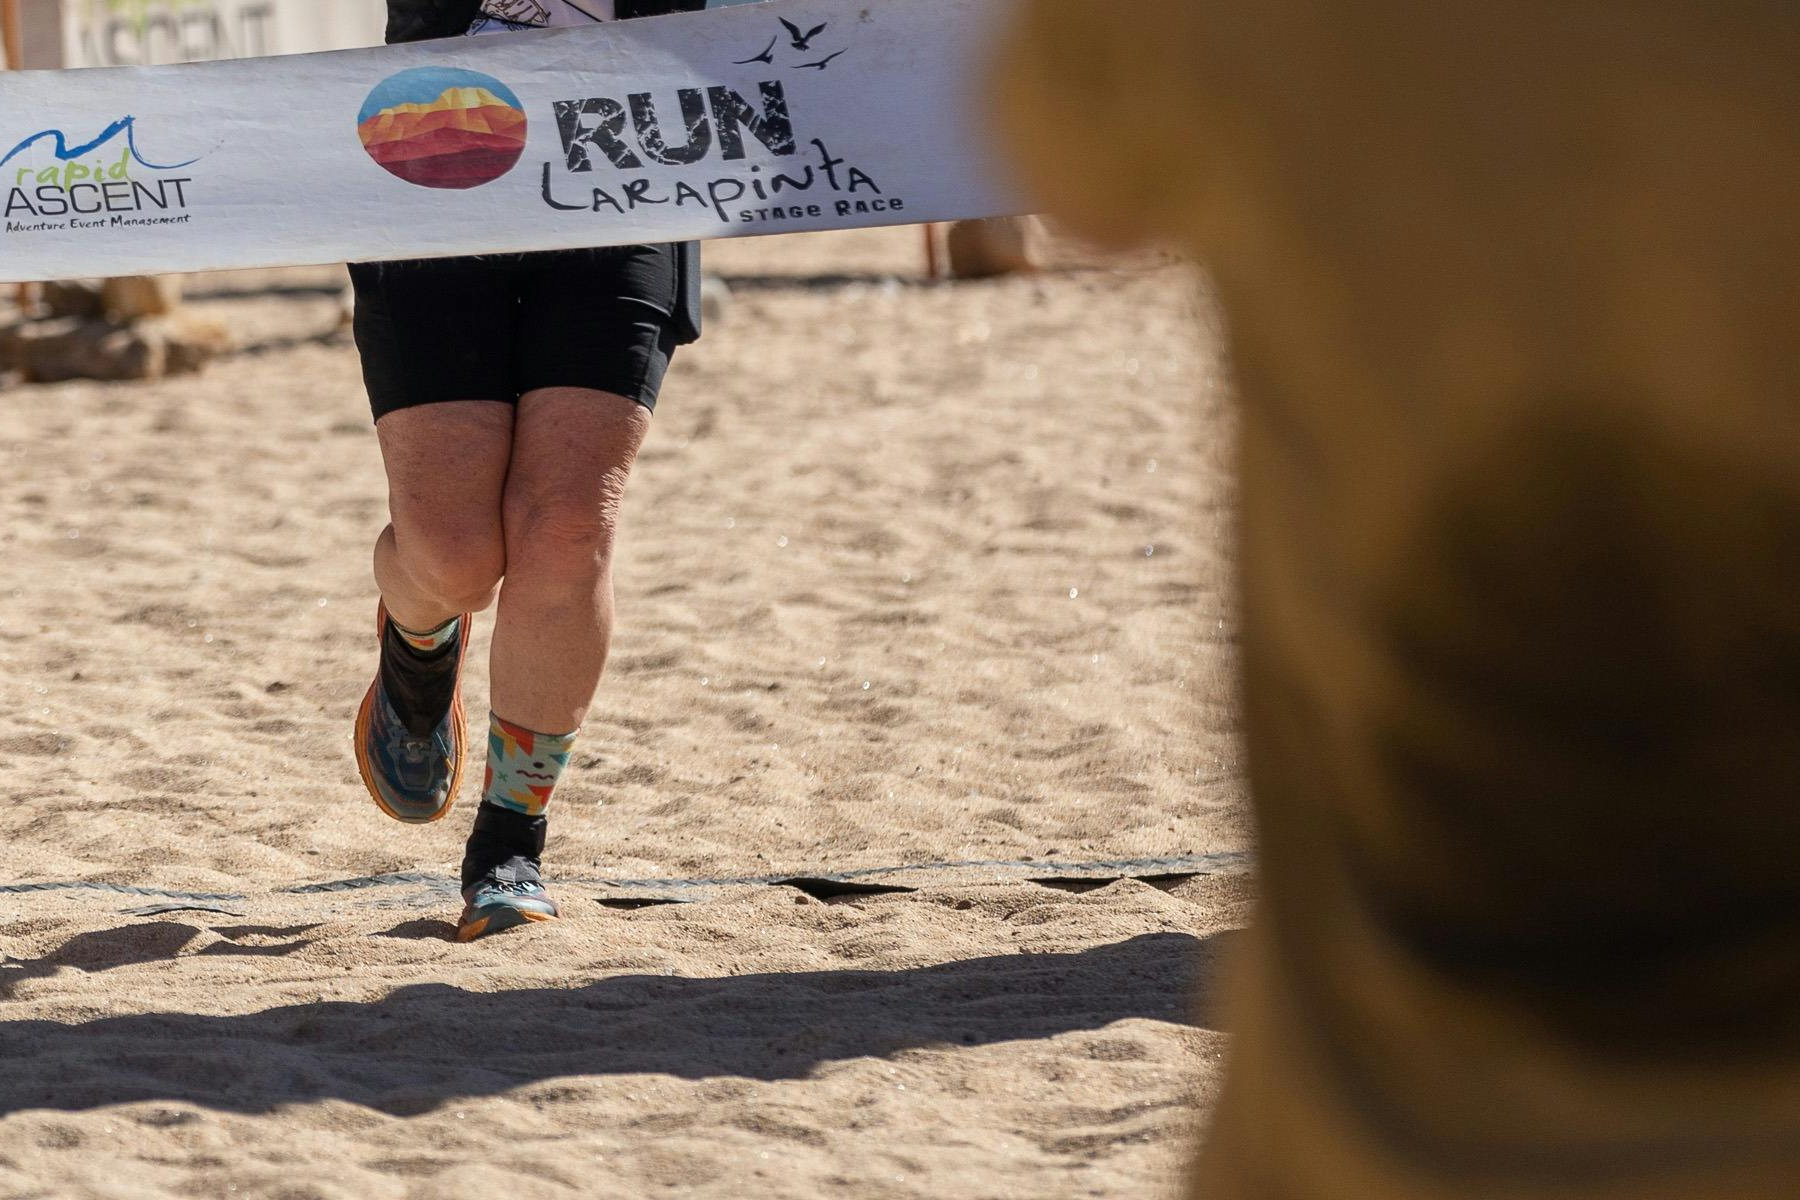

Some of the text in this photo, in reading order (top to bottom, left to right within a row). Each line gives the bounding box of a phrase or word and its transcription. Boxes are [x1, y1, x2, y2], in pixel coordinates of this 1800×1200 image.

[552, 79, 798, 173] RUN
[16, 147, 133, 192] rapid
[4, 178, 192, 218] ASCENT
[5, 213, 192, 233] Adventure Event Management
